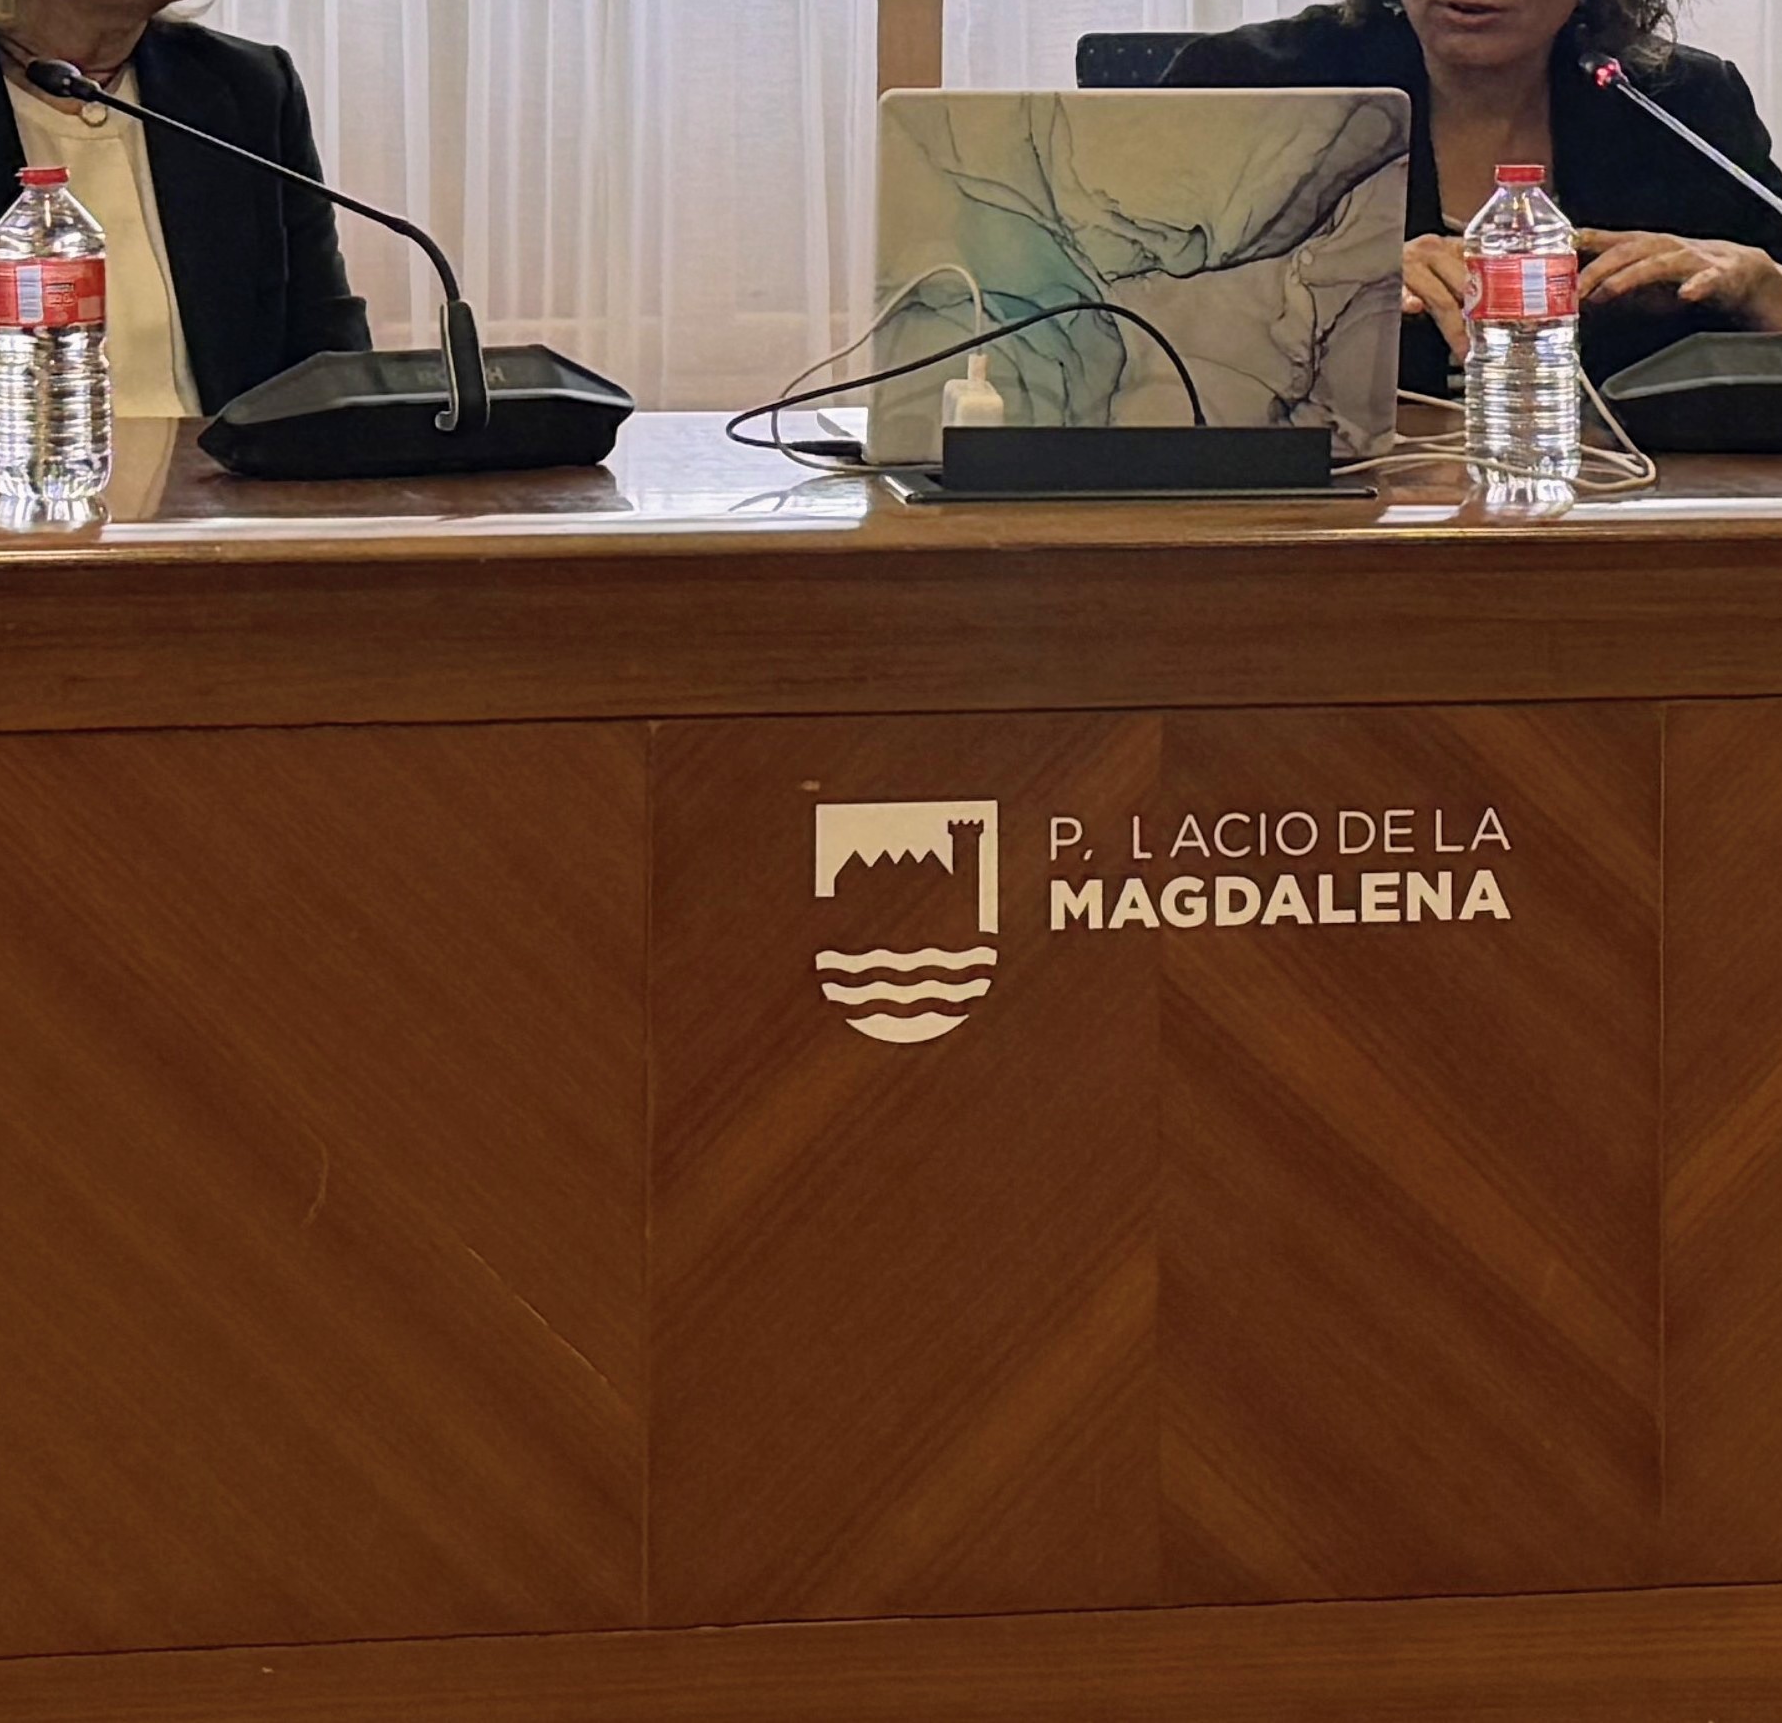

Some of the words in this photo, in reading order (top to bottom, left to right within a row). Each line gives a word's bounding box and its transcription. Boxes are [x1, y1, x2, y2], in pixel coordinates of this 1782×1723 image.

[1338, 809, 1415, 855] DE
[1435, 807, 1511, 853] LA
[1050, 870, 1511, 931] MAGDALENA
